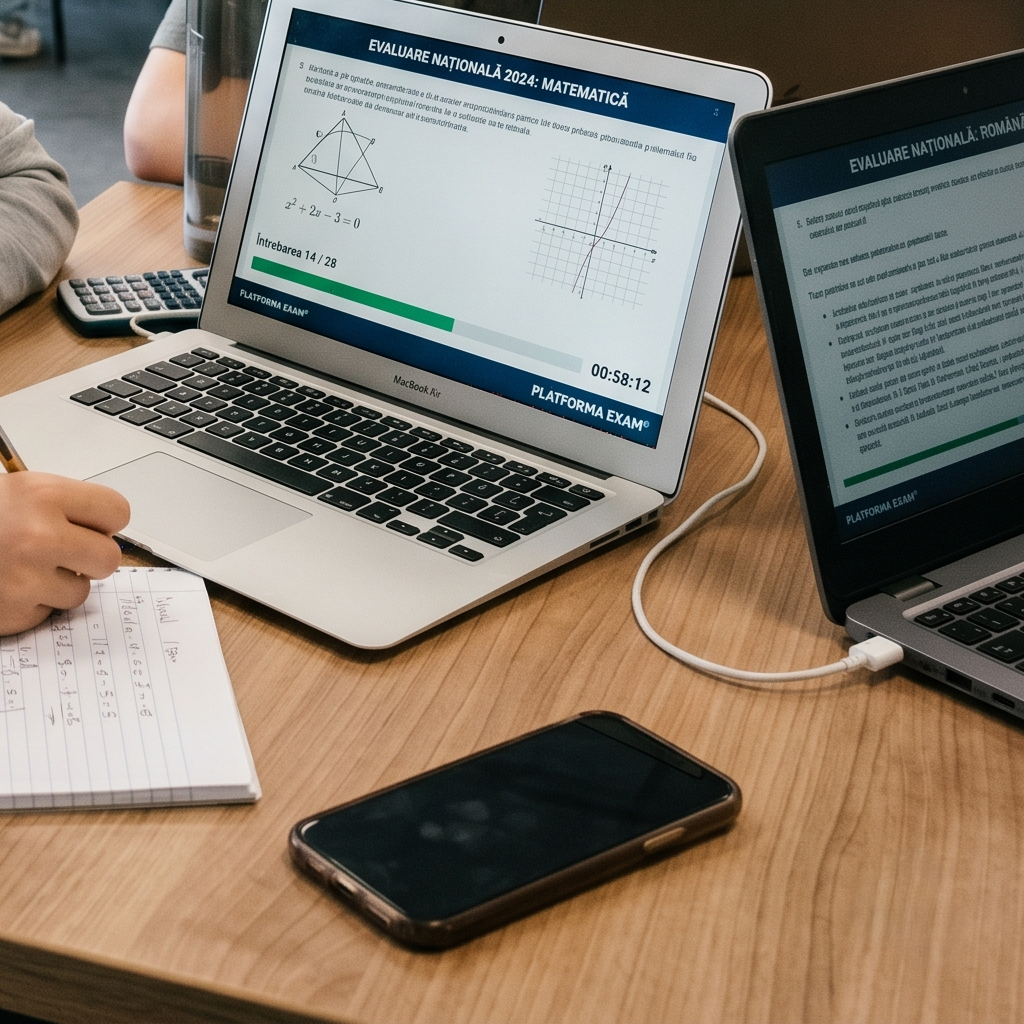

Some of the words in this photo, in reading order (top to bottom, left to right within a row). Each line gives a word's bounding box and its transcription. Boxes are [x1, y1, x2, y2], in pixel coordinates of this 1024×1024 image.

[368, 38, 430, 64] EVALUARE
[431, 49, 502, 80] NAȚIONALĂ
[504, 68, 539, 89] 2024:
[541, 77, 630, 108] MATEMATICĂ
[849, 145, 909, 174] EVALUARE
[256, 232, 302, 259] Întrebarea
[305, 249, 316, 263] 14
[324, 256, 337, 269] 28
[393, 375, 428, 395] MacBook
[429, 386, 441, 399] Air
[591, 363, 651, 394] 00:58:12
[531, 384, 604, 420] PLATFORMA
